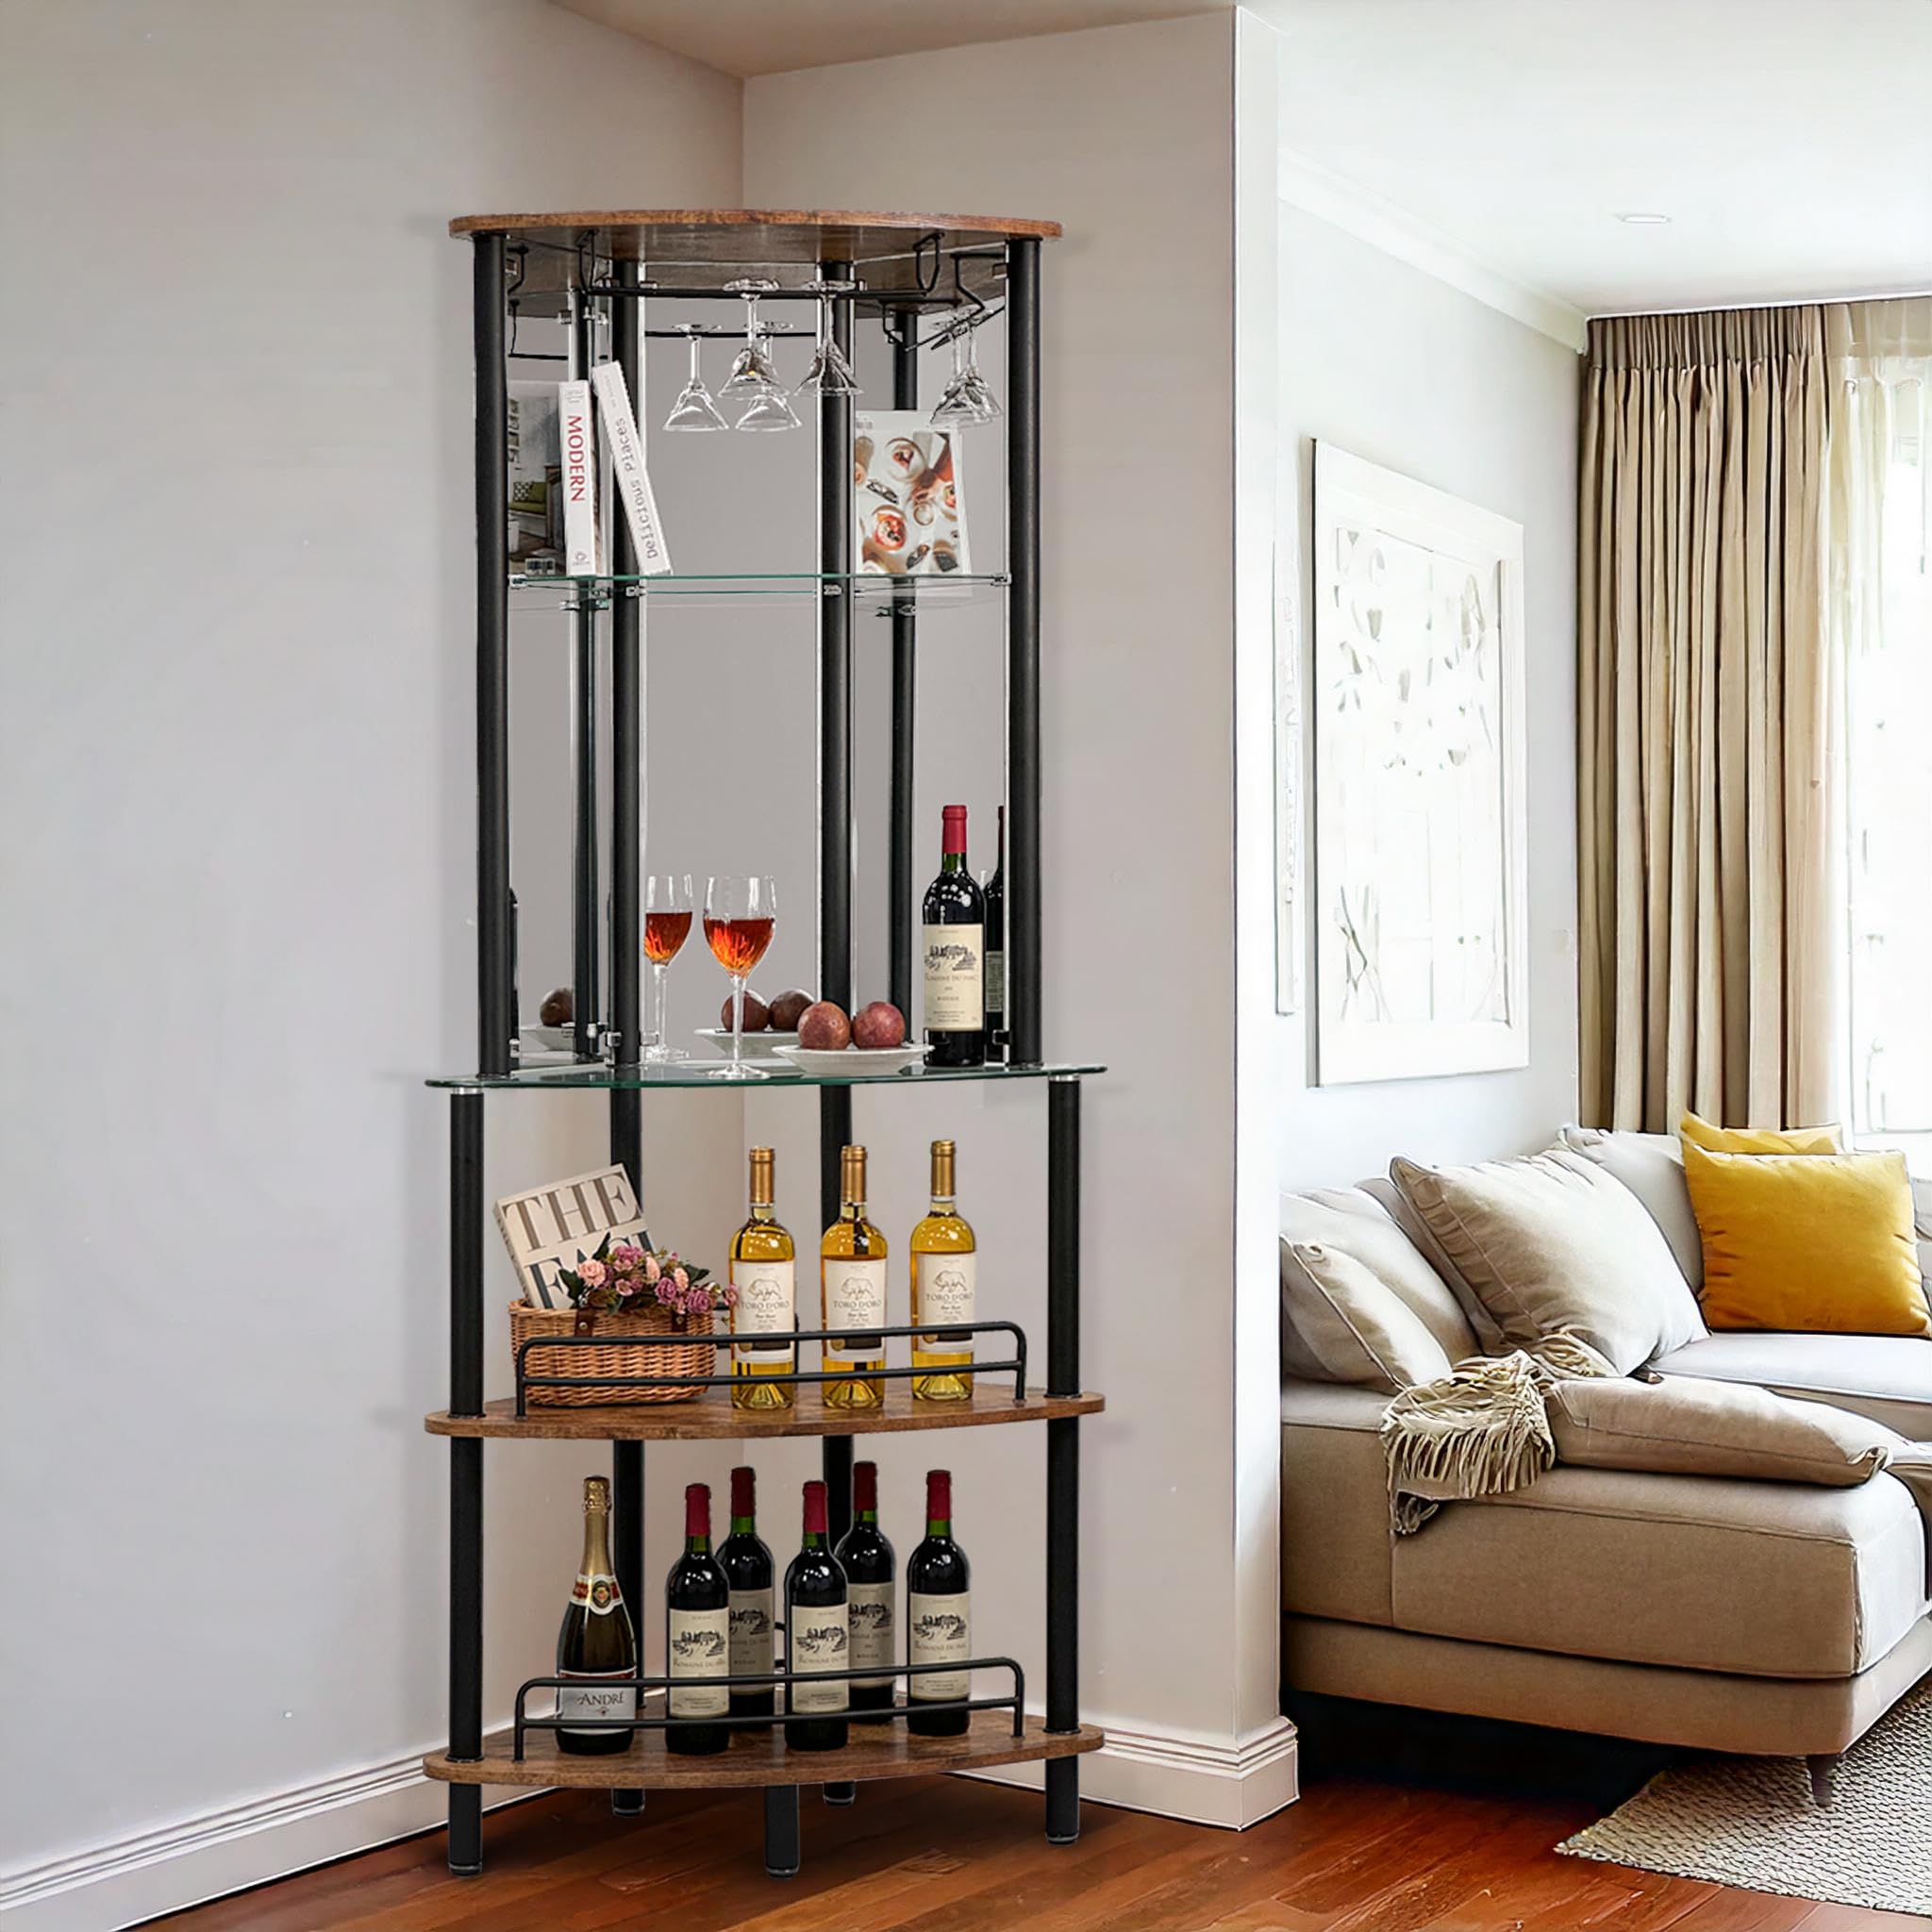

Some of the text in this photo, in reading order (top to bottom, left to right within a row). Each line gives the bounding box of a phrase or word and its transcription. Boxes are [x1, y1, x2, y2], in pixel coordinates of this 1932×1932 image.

[566, 415, 586, 502] MODERN
[615, 417, 658, 559] Delicious Places
[502, 1172, 642, 1253] THE
[741, 1301, 764, 1309] TORO
[833, 1300, 857, 1308] TORO
[926, 1292, 950, 1302] TORO
